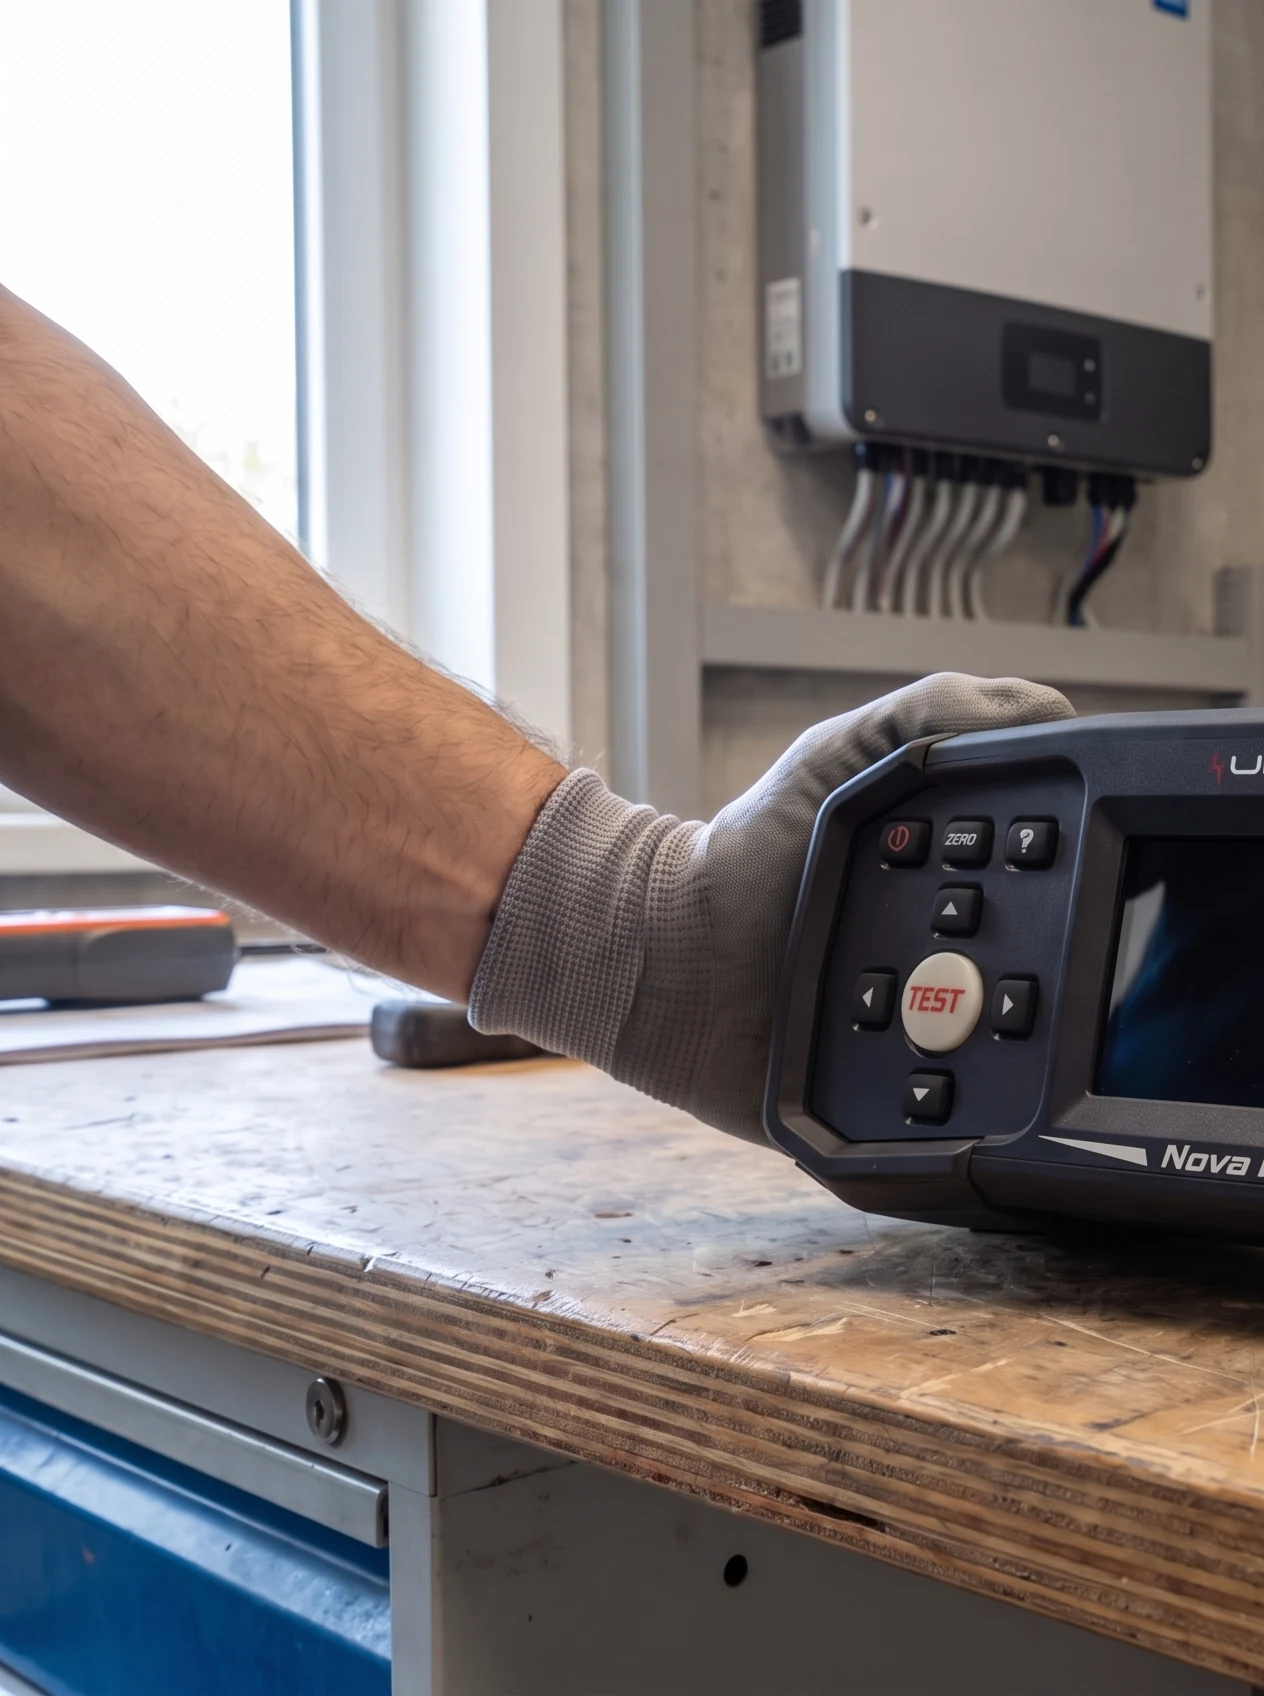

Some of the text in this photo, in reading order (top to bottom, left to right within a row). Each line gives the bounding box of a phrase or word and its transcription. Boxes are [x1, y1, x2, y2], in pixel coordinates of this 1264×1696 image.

[944, 833, 977, 846] ZERO
[1020, 828, 1034, 854] ?
[908, 986, 966, 1014] TEST
[1160, 1144, 1252, 1176] Nova
